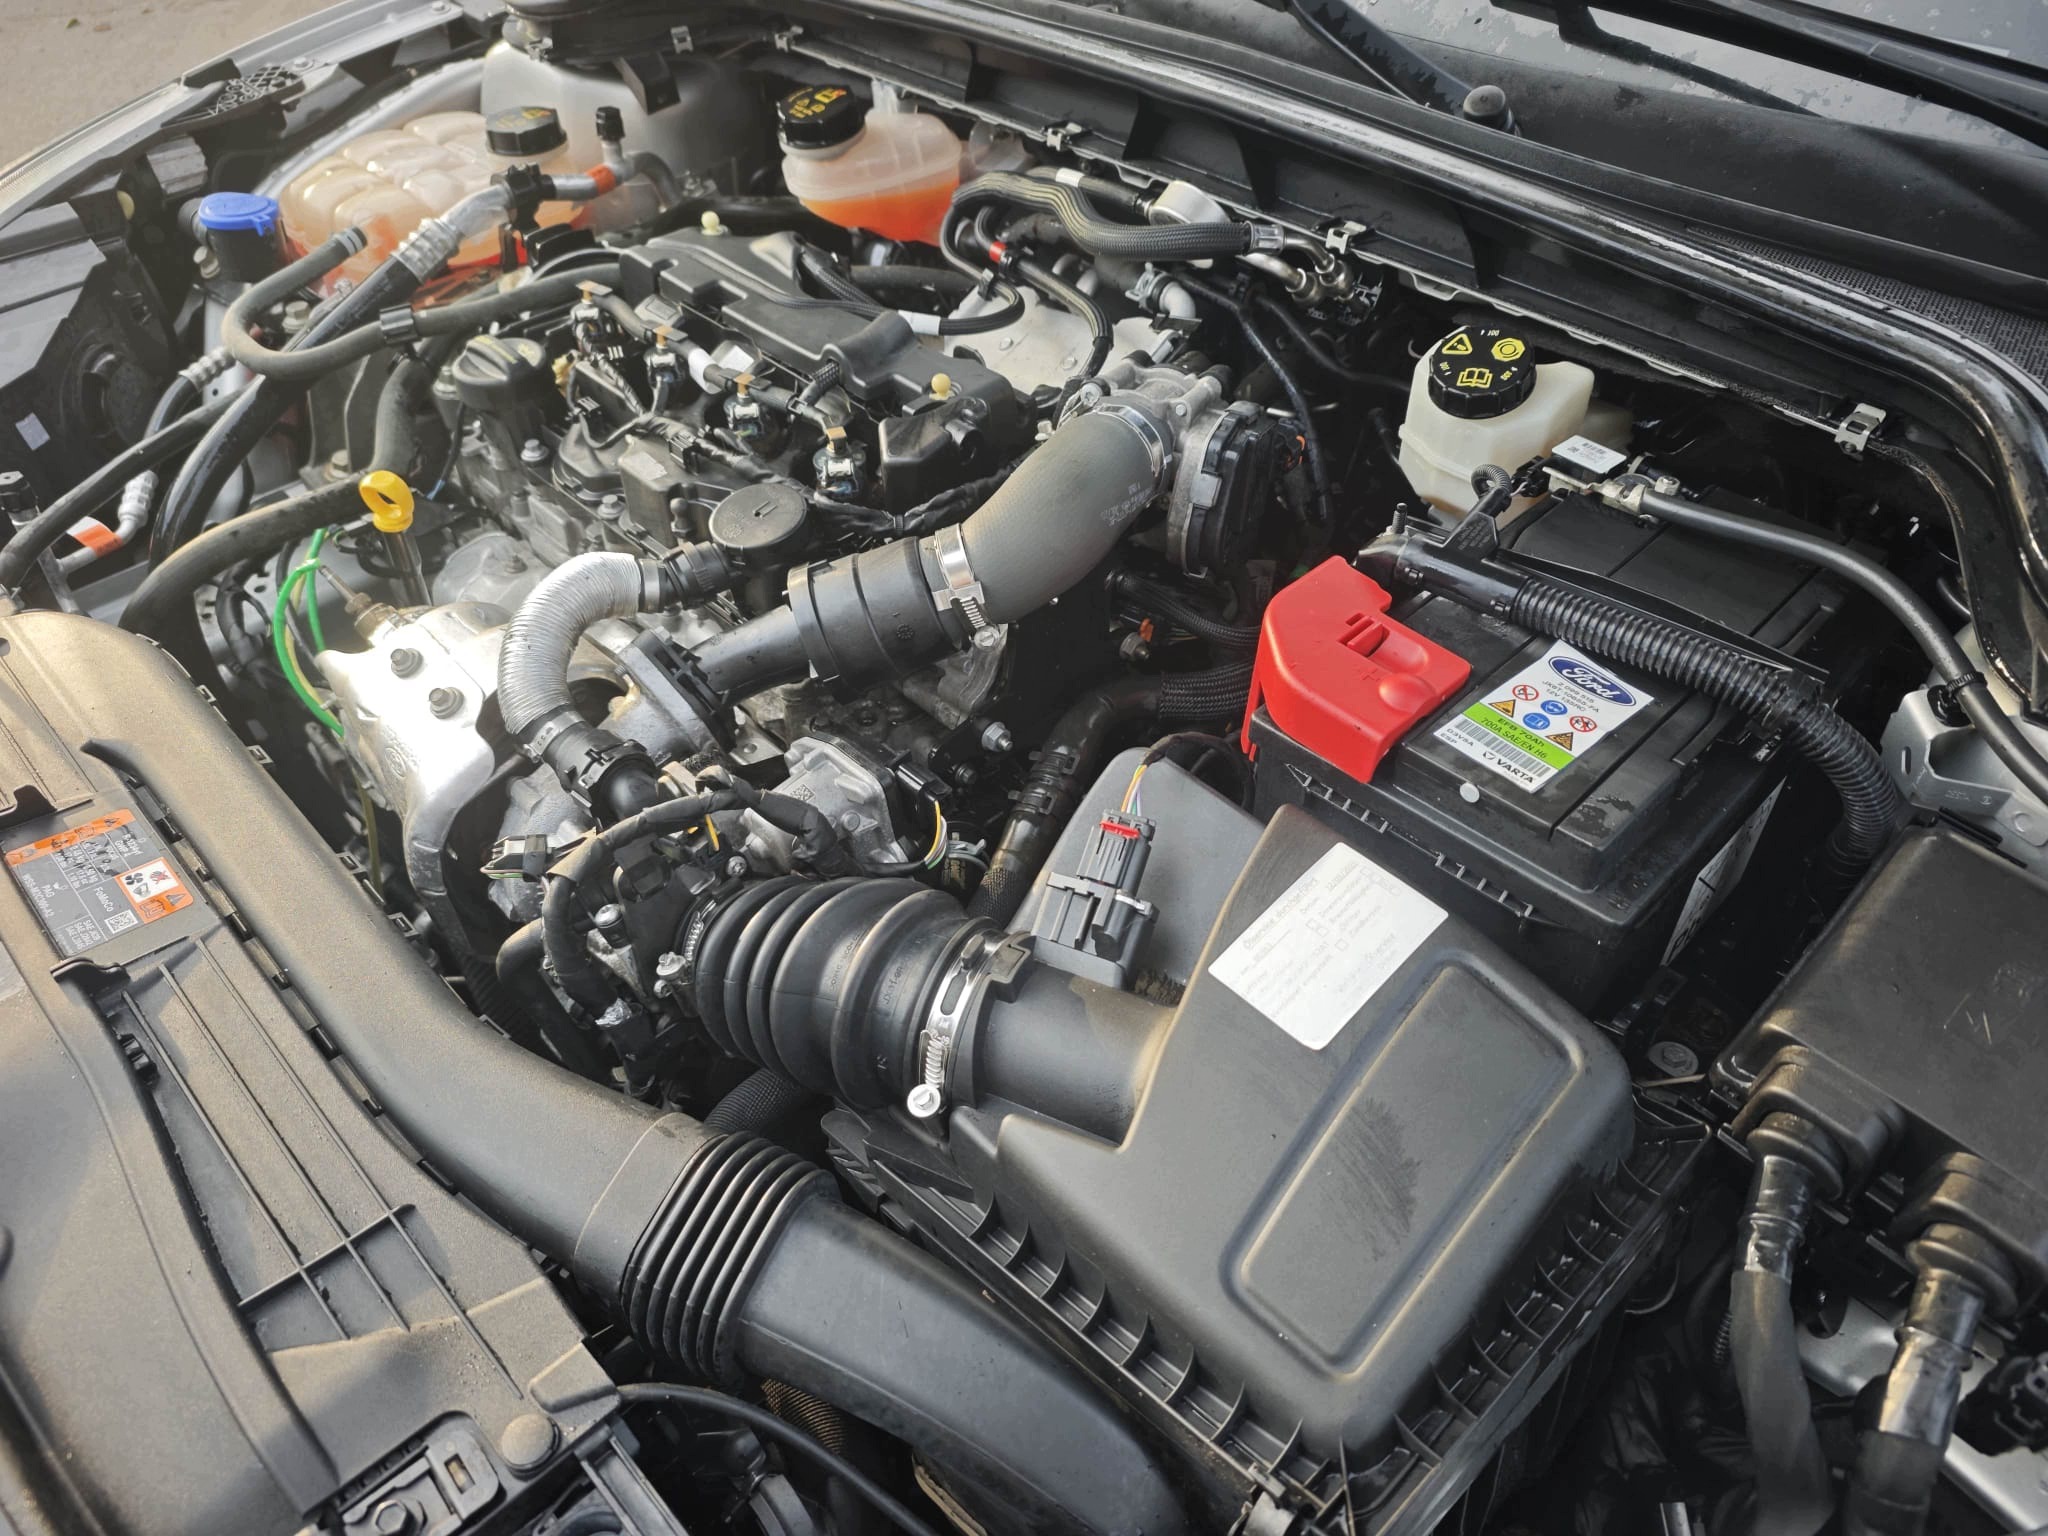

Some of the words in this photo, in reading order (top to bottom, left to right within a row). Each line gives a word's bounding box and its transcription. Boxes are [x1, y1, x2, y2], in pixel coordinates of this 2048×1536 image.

[1561, 666, 1619, 698] Ford
[1482, 718, 1502, 732] 700A
[1503, 731, 1534, 750] SAE/EN
[1534, 750, 1546, 758] H6
[1498, 718, 1517, 731] EFB
[1520, 730, 1544, 747] 70Ah
[1497, 758, 1534, 784] VARTA
[41, 884, 55, 897] PAG
[94, 886, 114, 912] FoMoCo
